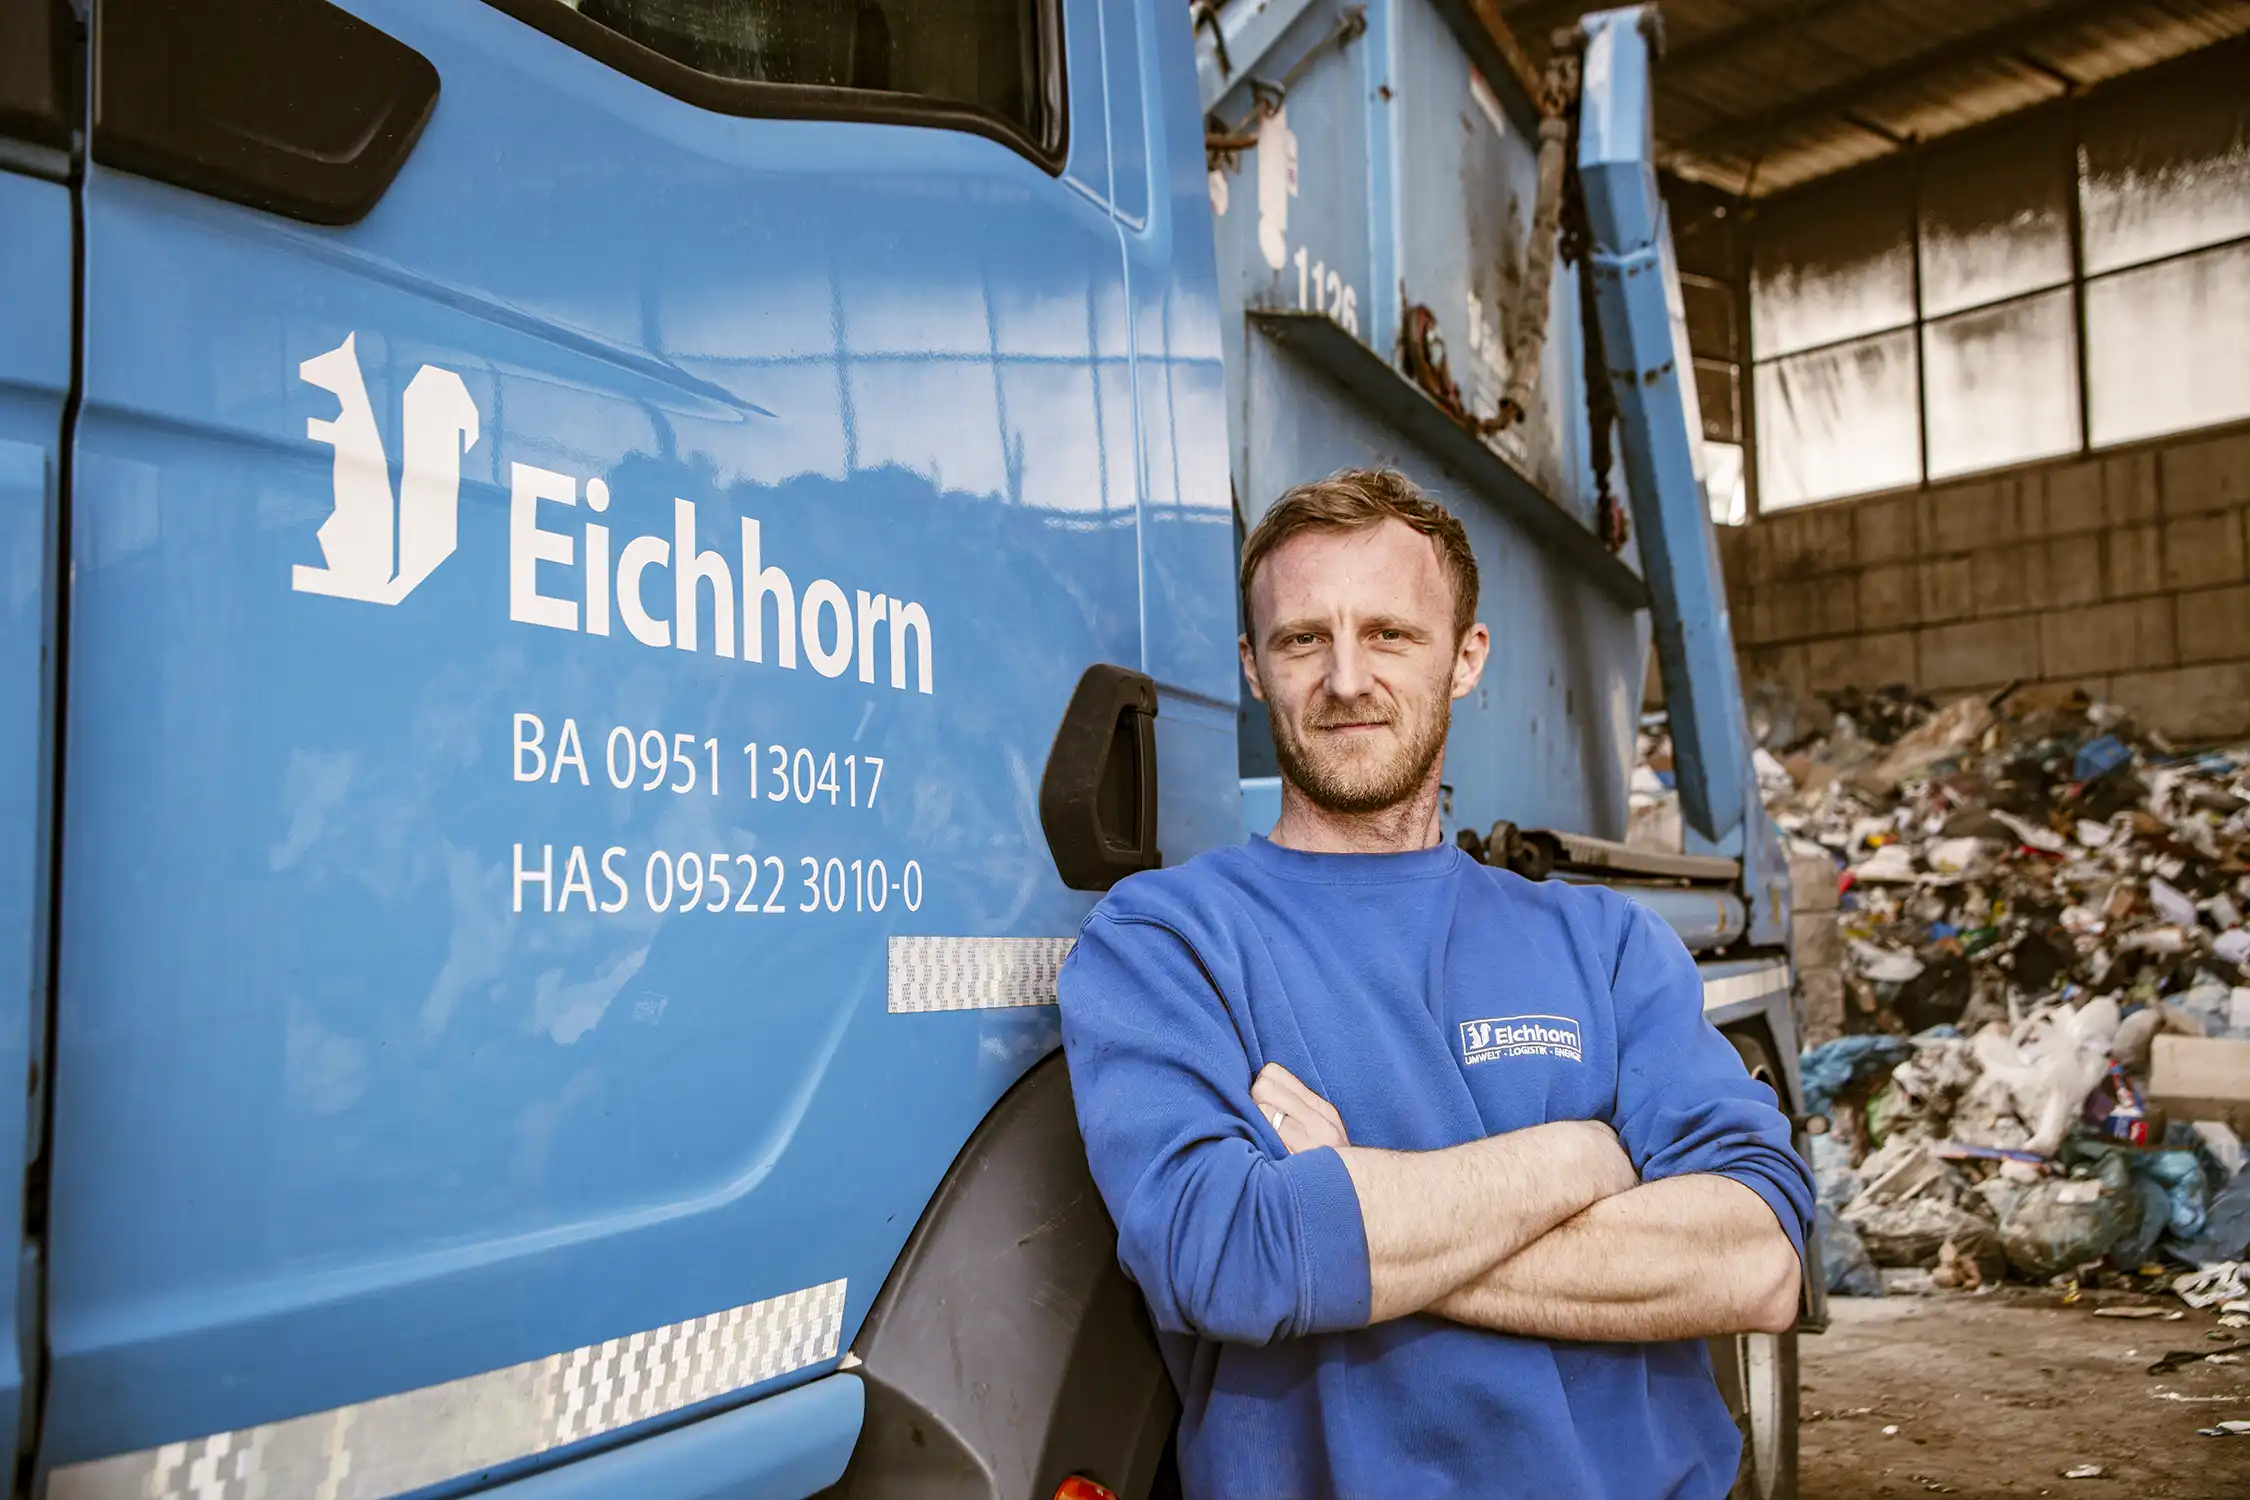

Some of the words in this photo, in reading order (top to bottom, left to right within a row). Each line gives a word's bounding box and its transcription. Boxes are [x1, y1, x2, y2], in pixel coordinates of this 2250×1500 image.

[1293, 245, 1359, 339] 1126
[510, 462, 932, 694] Eichhorn
[513, 713, 590, 786] BA
[607, 726, 719, 796] 0951
[744, 743, 884, 809] 130417
[512, 843, 629, 914] HAS
[646, 850, 786, 914] 09522
[800, 857, 923, 913] 3010-0
[1464, 1050, 1502, 1065] UMWELT
[1508, 1046, 1548, 1057] LOGISTIK
[1494, 1024, 1578, 1047] Eichhorn
